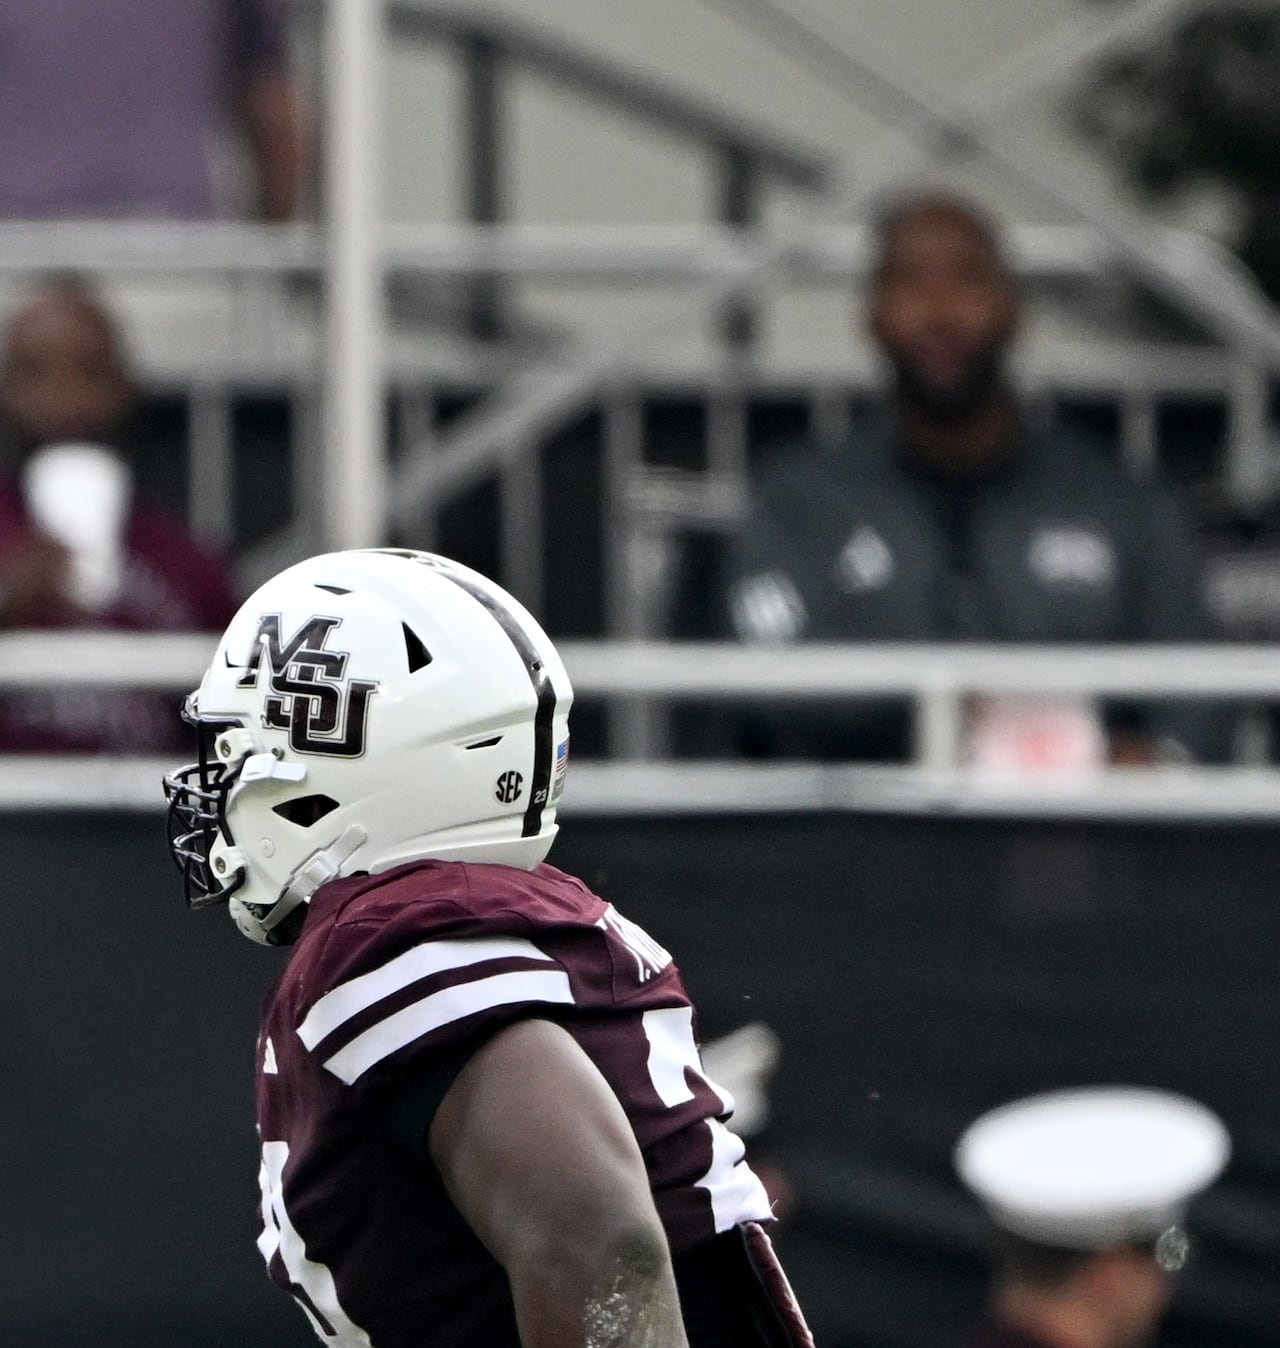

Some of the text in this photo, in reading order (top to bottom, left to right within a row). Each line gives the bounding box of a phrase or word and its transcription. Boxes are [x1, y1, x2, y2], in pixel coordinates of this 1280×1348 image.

[236, 612, 380, 759] MSU
[495, 770, 523, 803] SEC
[533, 788, 547, 804] 23
